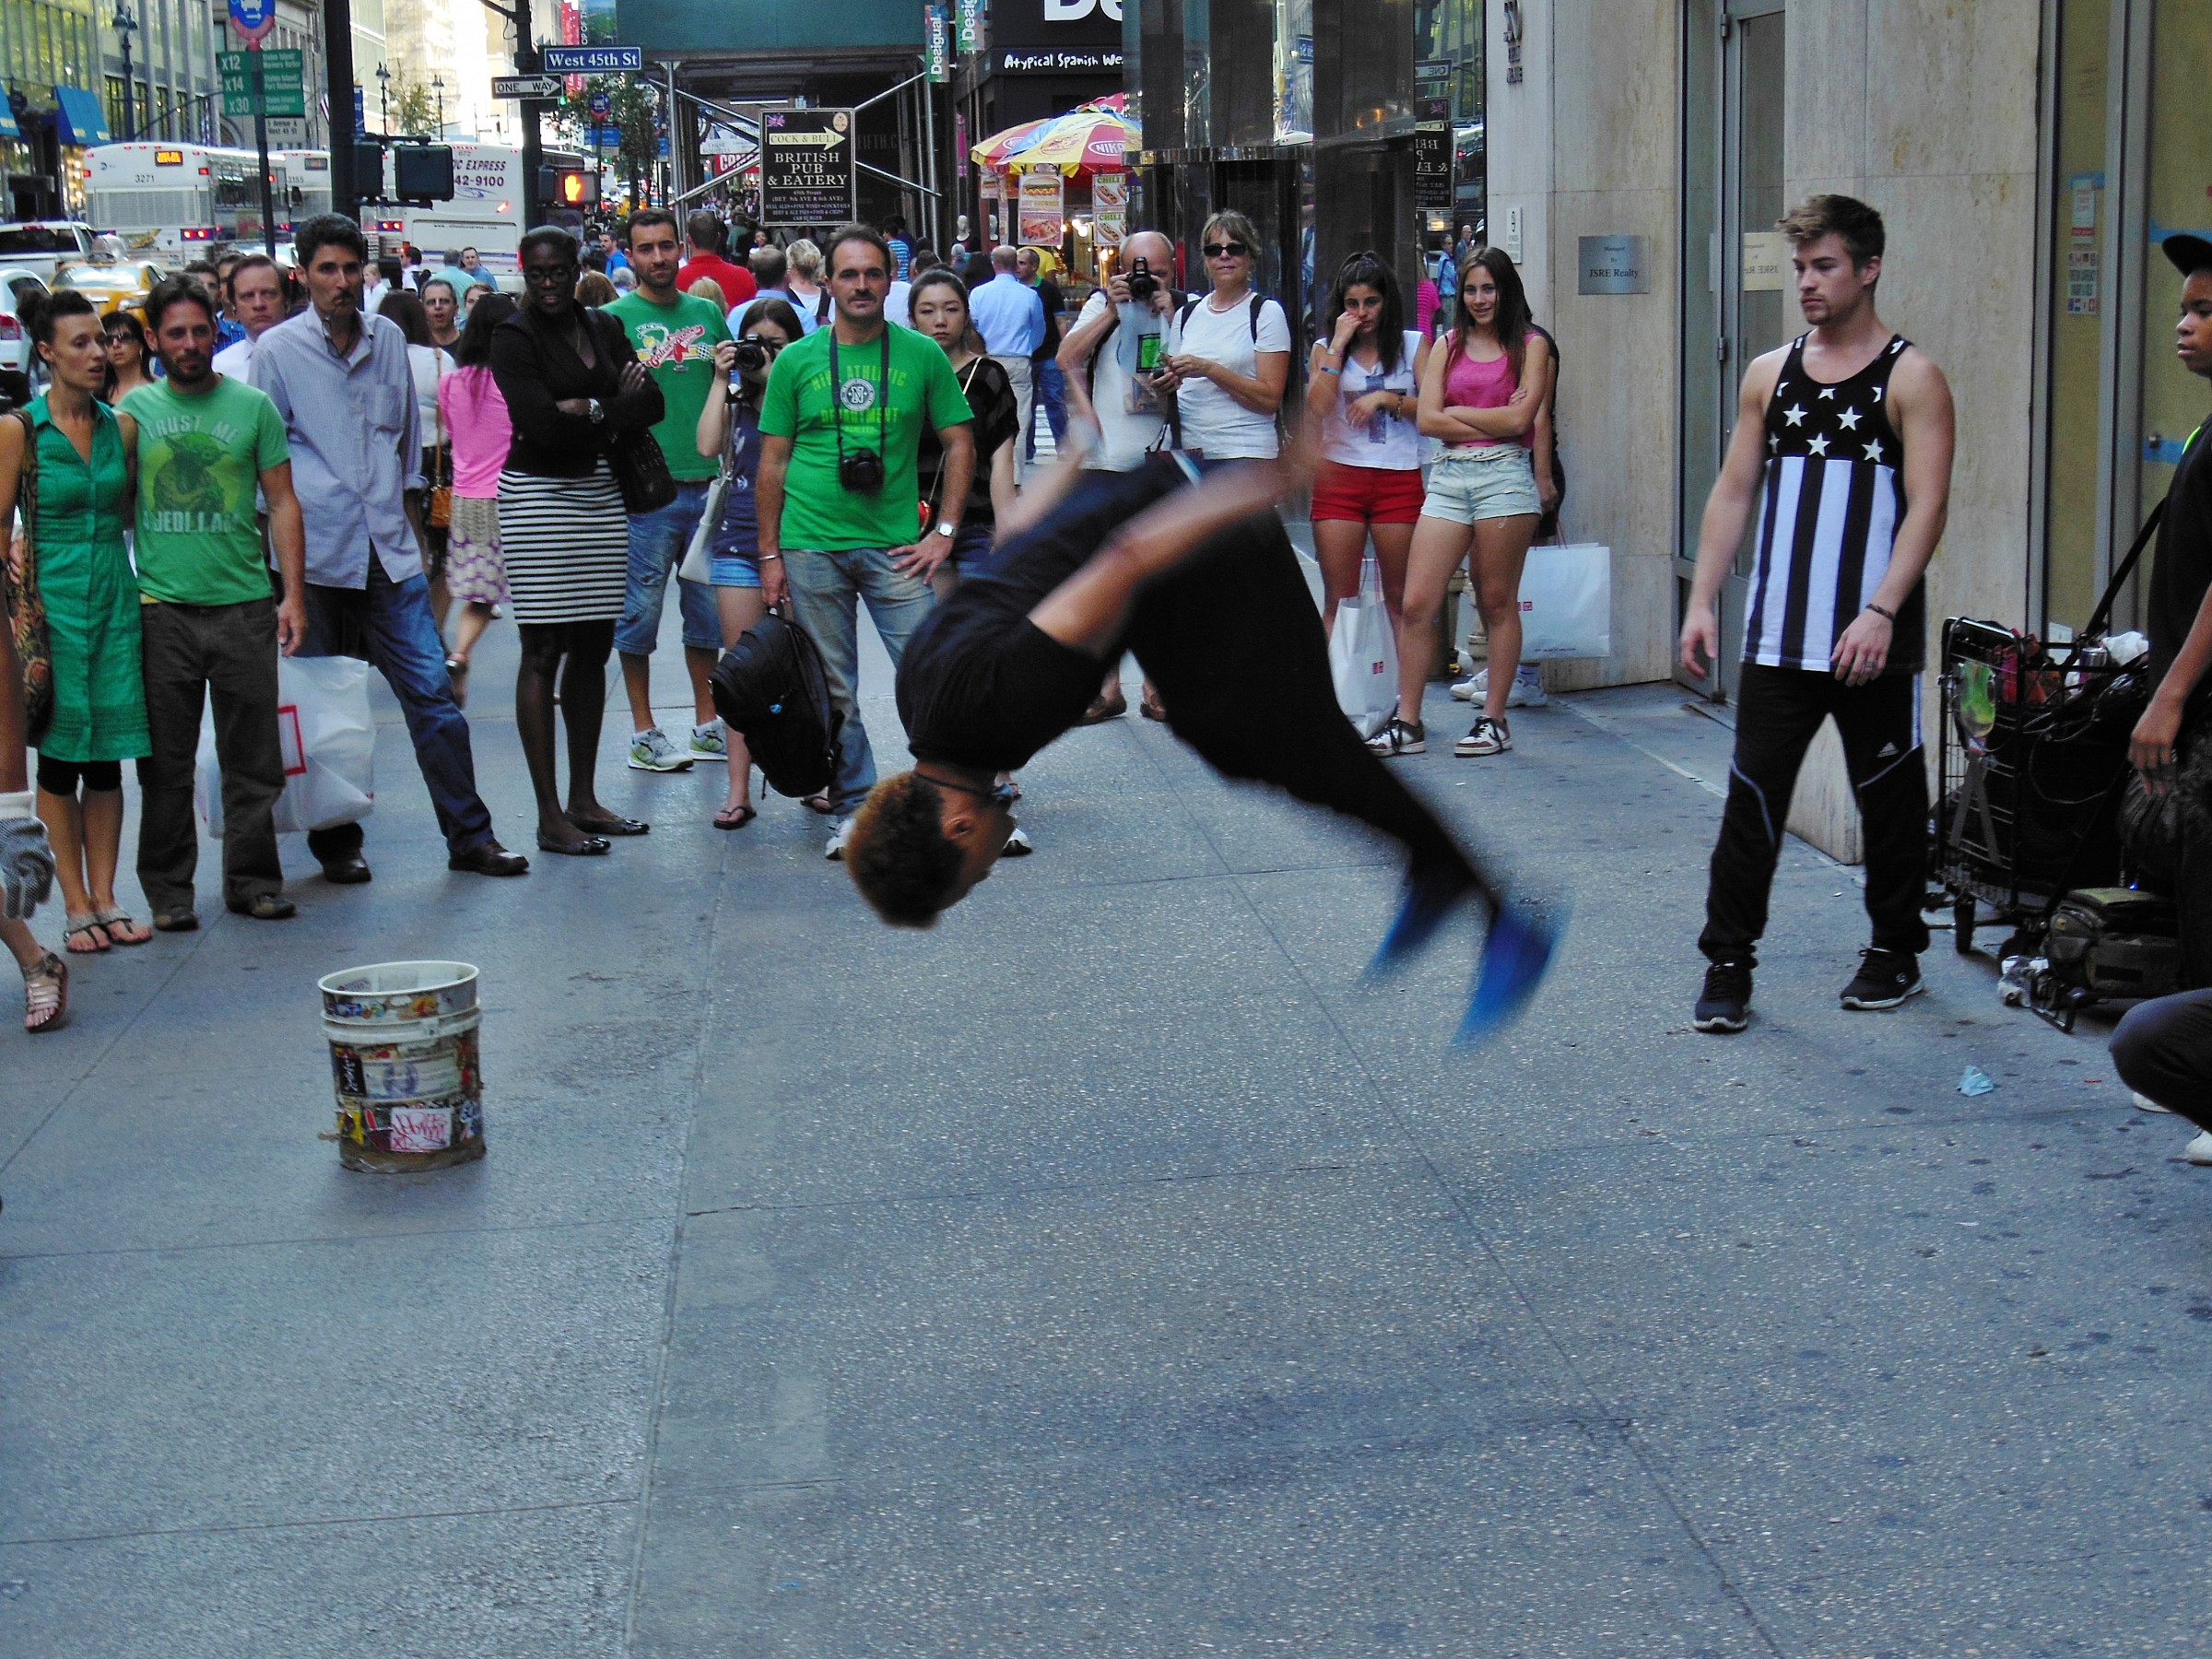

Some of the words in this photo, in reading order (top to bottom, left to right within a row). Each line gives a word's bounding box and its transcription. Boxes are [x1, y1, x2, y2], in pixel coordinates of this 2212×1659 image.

[548, 53, 584, 66] West
[588, 52, 618, 66] 45th
[622, 51, 638, 65] St
[1004, 53, 1053, 70] Atypical
[1057, 53, 1099, 70] Spanish
[1102, 54, 1123, 66] We
[497, 82, 520, 92] ONE
[532, 81, 554, 92] WAY
[771, 135, 799, 144] COCK
[812, 135, 839, 144] BULL
[774, 152, 840, 163] BRITISH
[466, 159, 506, 171] EXPRESS
[791, 163, 823, 174] PUB
[135, 173, 155, 183] 3271
[454, 175, 504, 186] 42-9100
[767, 175, 778, 186] &
[782, 174, 848, 186] EATERY
[1589, 268, 1612, 277] JSRE
[1613, 268, 1639, 279] Realty
[846, 364, 907, 387] ATHLIC
[147, 415, 203, 440] TRUST
[210, 421, 239, 444] ME
